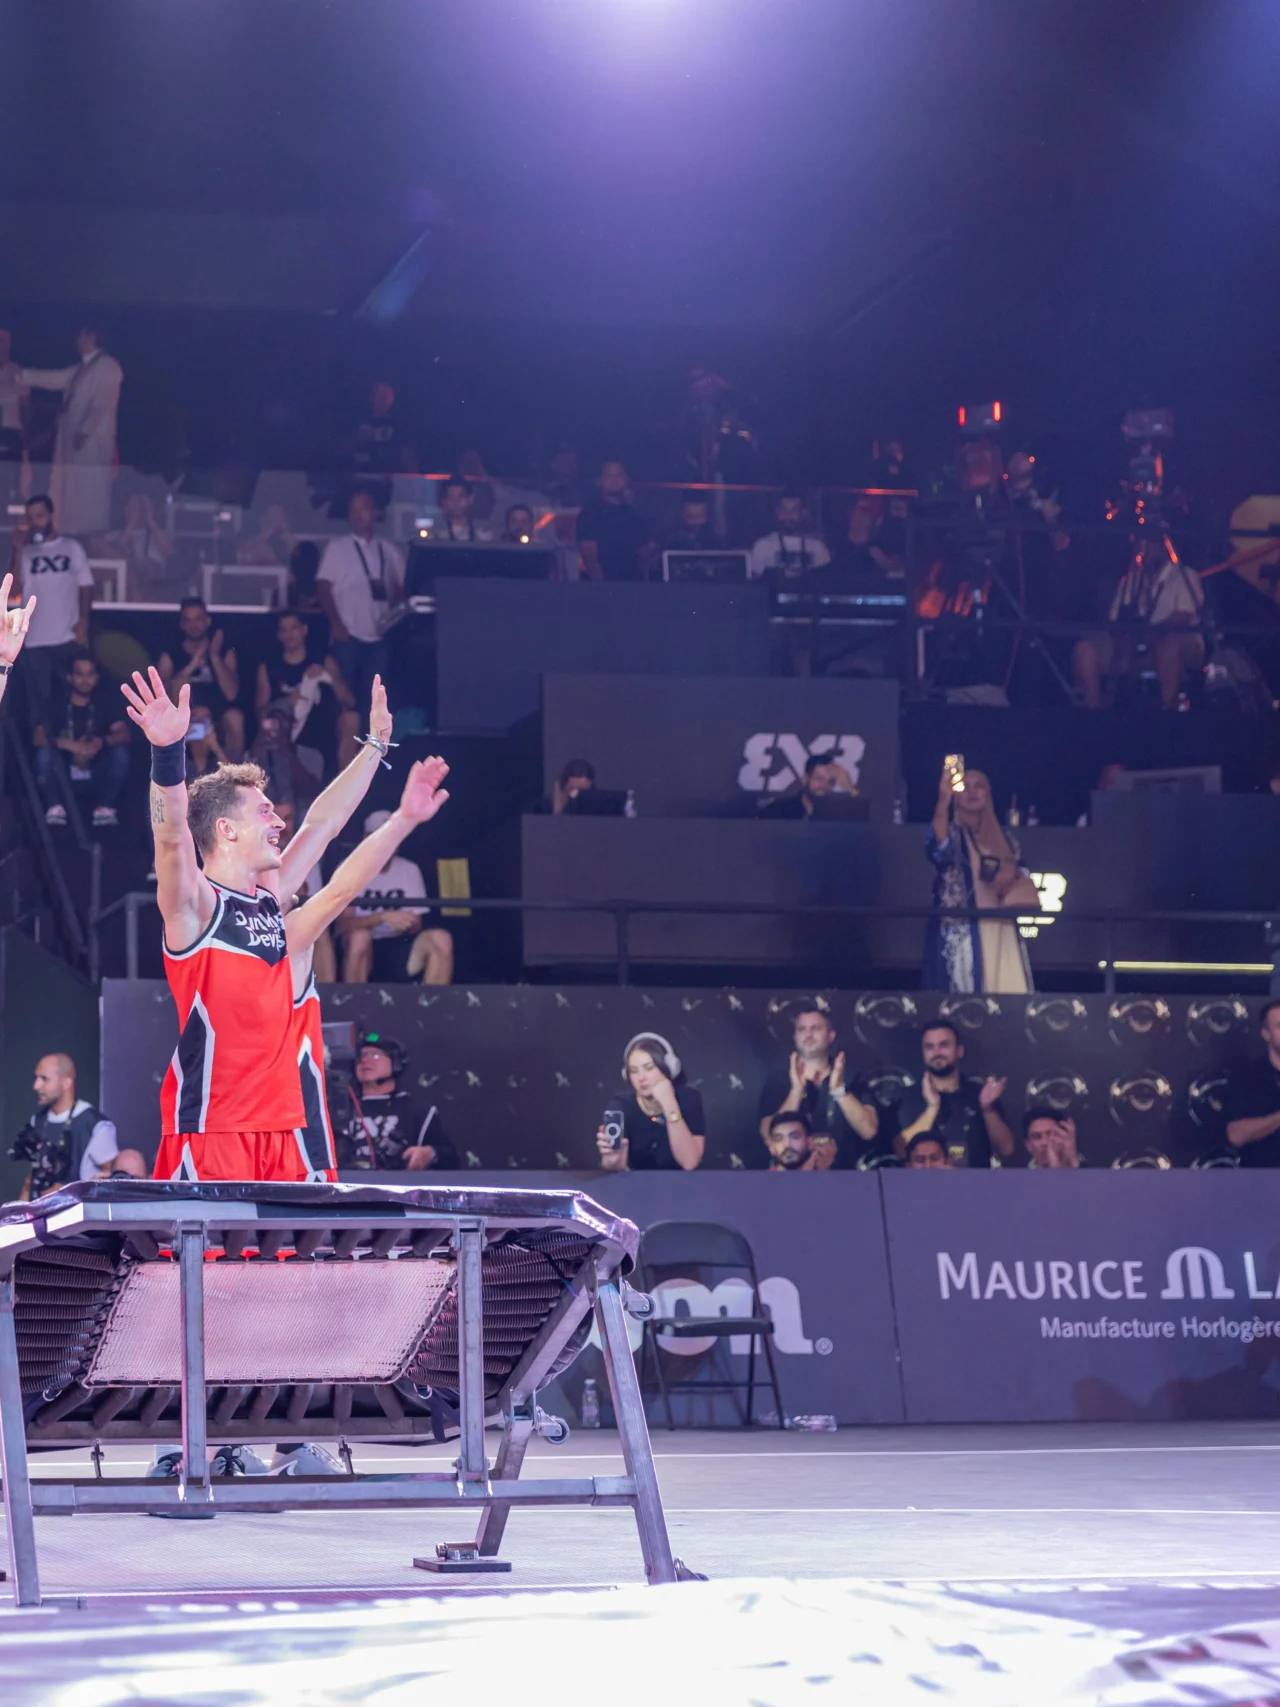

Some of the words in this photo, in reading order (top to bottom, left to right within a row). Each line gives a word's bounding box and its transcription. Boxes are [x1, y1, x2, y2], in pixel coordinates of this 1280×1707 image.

[936, 1251, 1148, 1300] MAURICE
[1243, 1251, 1280, 1300] L
[1039, 1316, 1176, 1339] Manufacture
[1181, 1316, 1280, 1344] Horlogère
